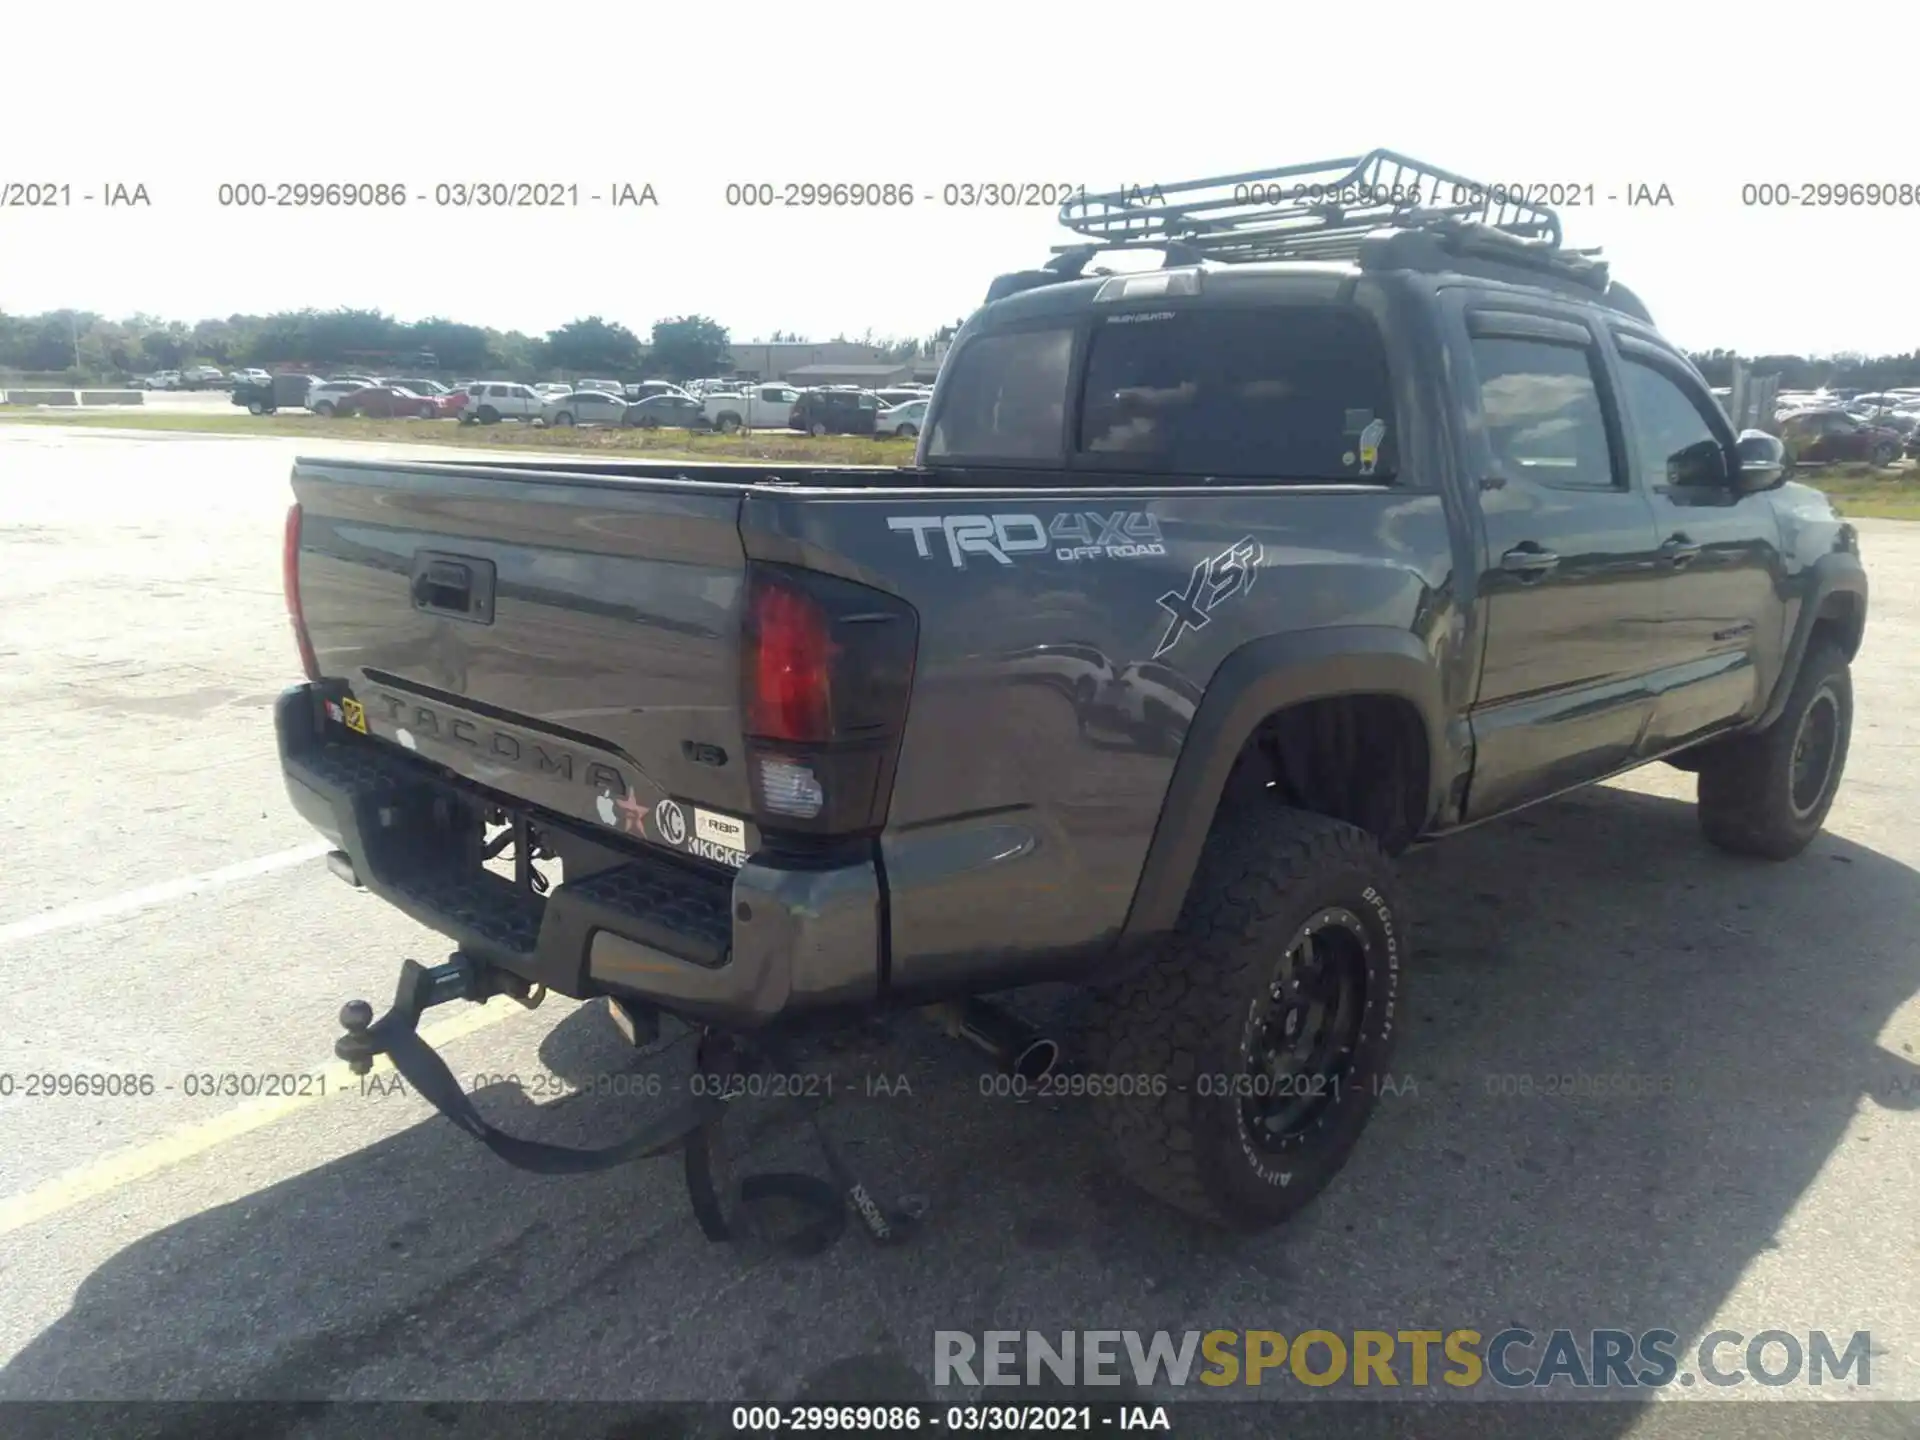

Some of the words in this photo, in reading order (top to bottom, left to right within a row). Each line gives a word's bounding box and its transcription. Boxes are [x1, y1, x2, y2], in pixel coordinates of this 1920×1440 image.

[886, 513, 1049, 567] TRD
[1055, 546, 1106, 562] OFF
[1107, 543, 1167, 558] ROAD
[380, 692, 628, 796] TACOMA
[680, 738, 730, 768] V6
[658, 800, 684, 842] KC
[708, 819, 740, 834] RBP
[699, 839, 751, 869] KICKE
